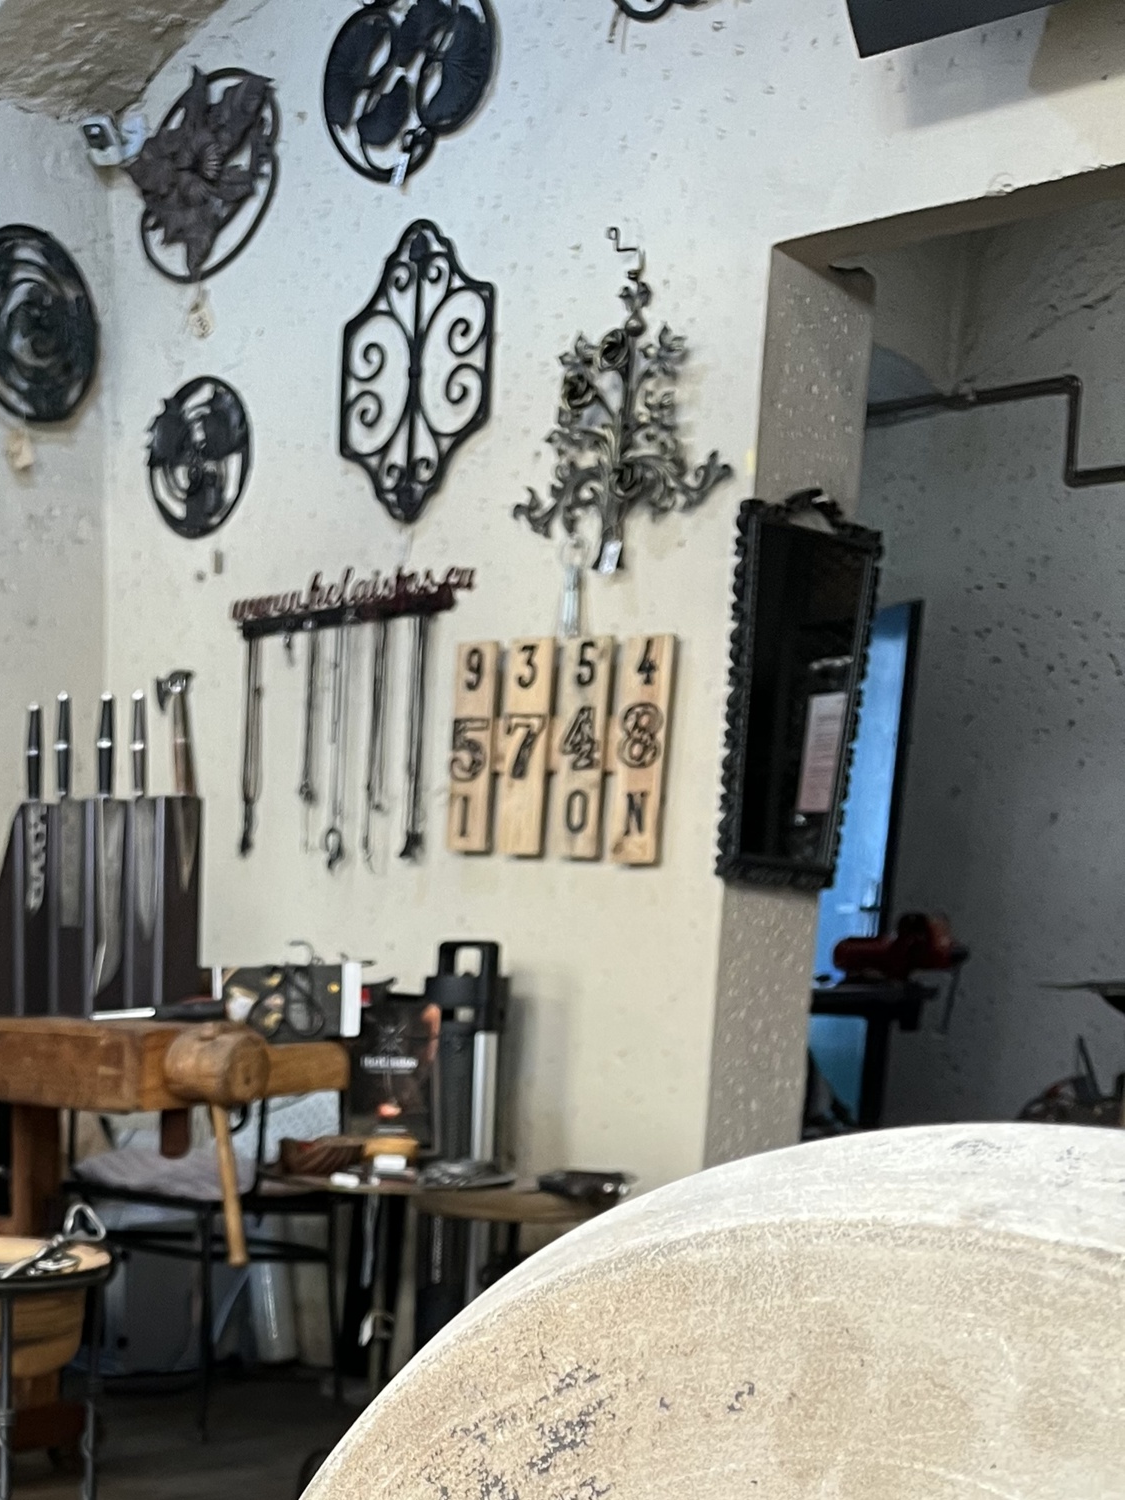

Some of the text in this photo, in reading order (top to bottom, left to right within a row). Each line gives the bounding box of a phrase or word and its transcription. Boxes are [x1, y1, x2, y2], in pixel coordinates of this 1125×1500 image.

[464, 639, 657, 692] 9 3 5 4
[449, 701, 664, 782] 5 7 4 8
[623, 791, 649, 837] N
